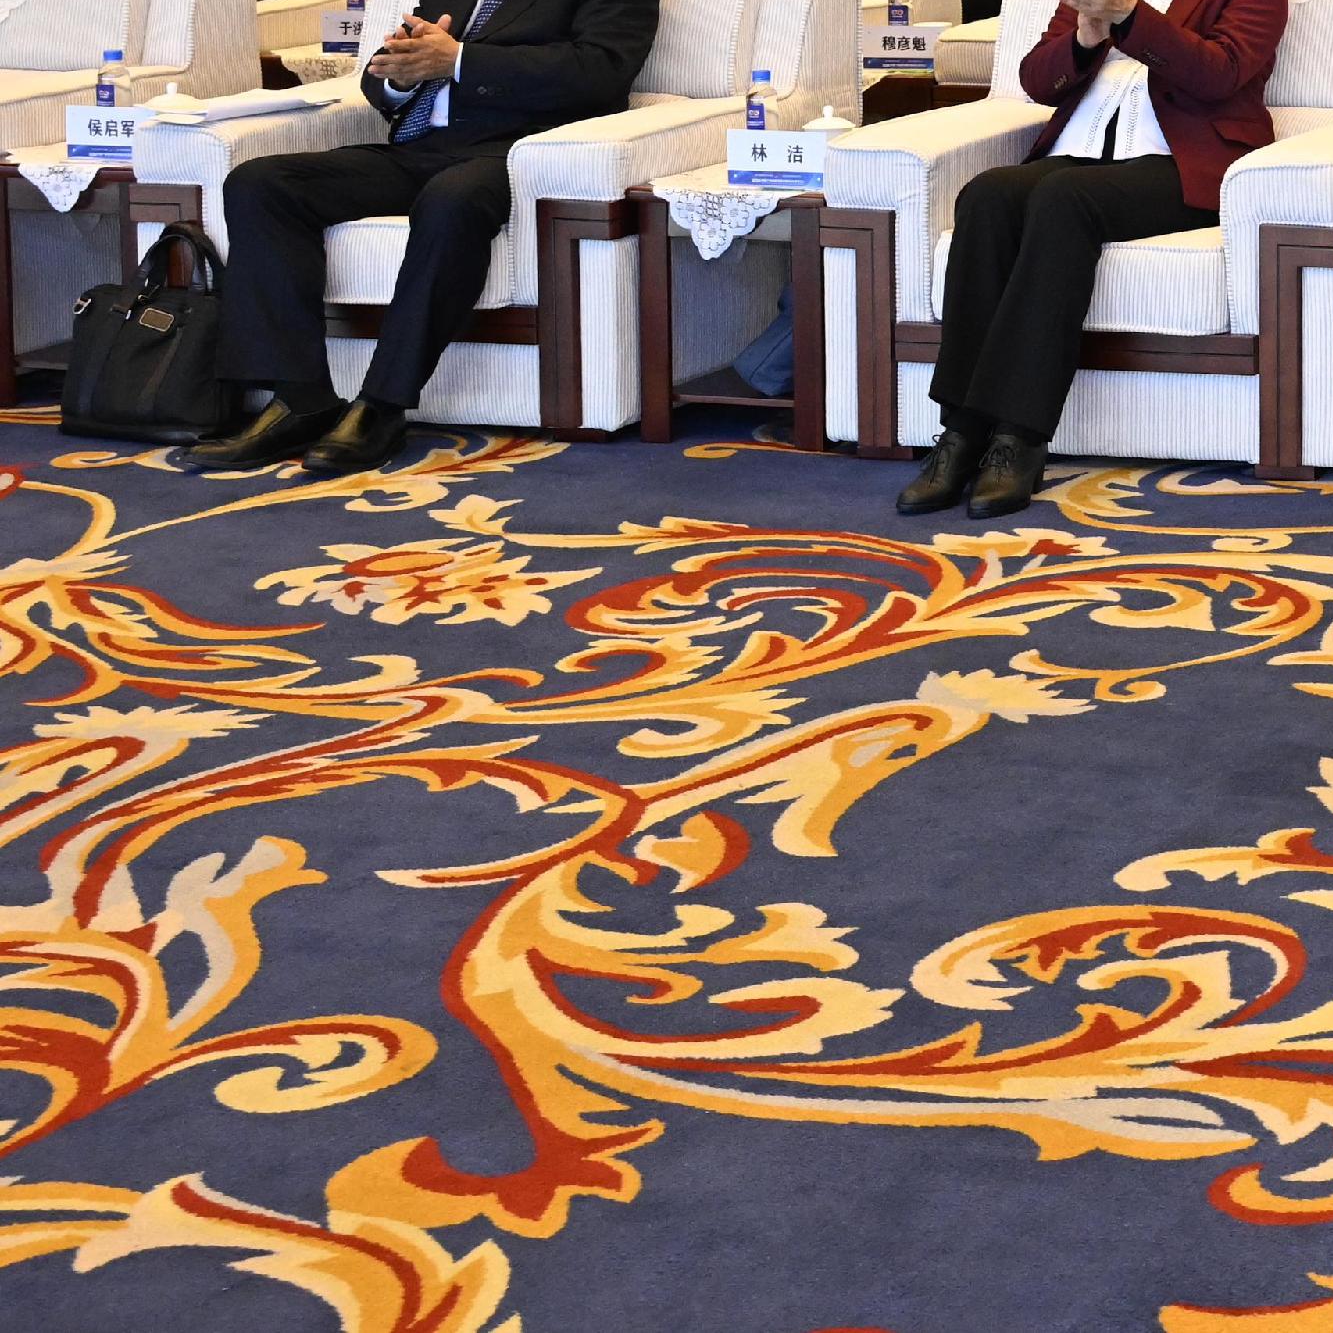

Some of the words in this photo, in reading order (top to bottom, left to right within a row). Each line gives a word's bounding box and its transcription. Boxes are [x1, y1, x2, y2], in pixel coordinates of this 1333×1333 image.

[882, 35, 927, 51] 穆彦魁
[87, 118, 135, 138] 侯启军
